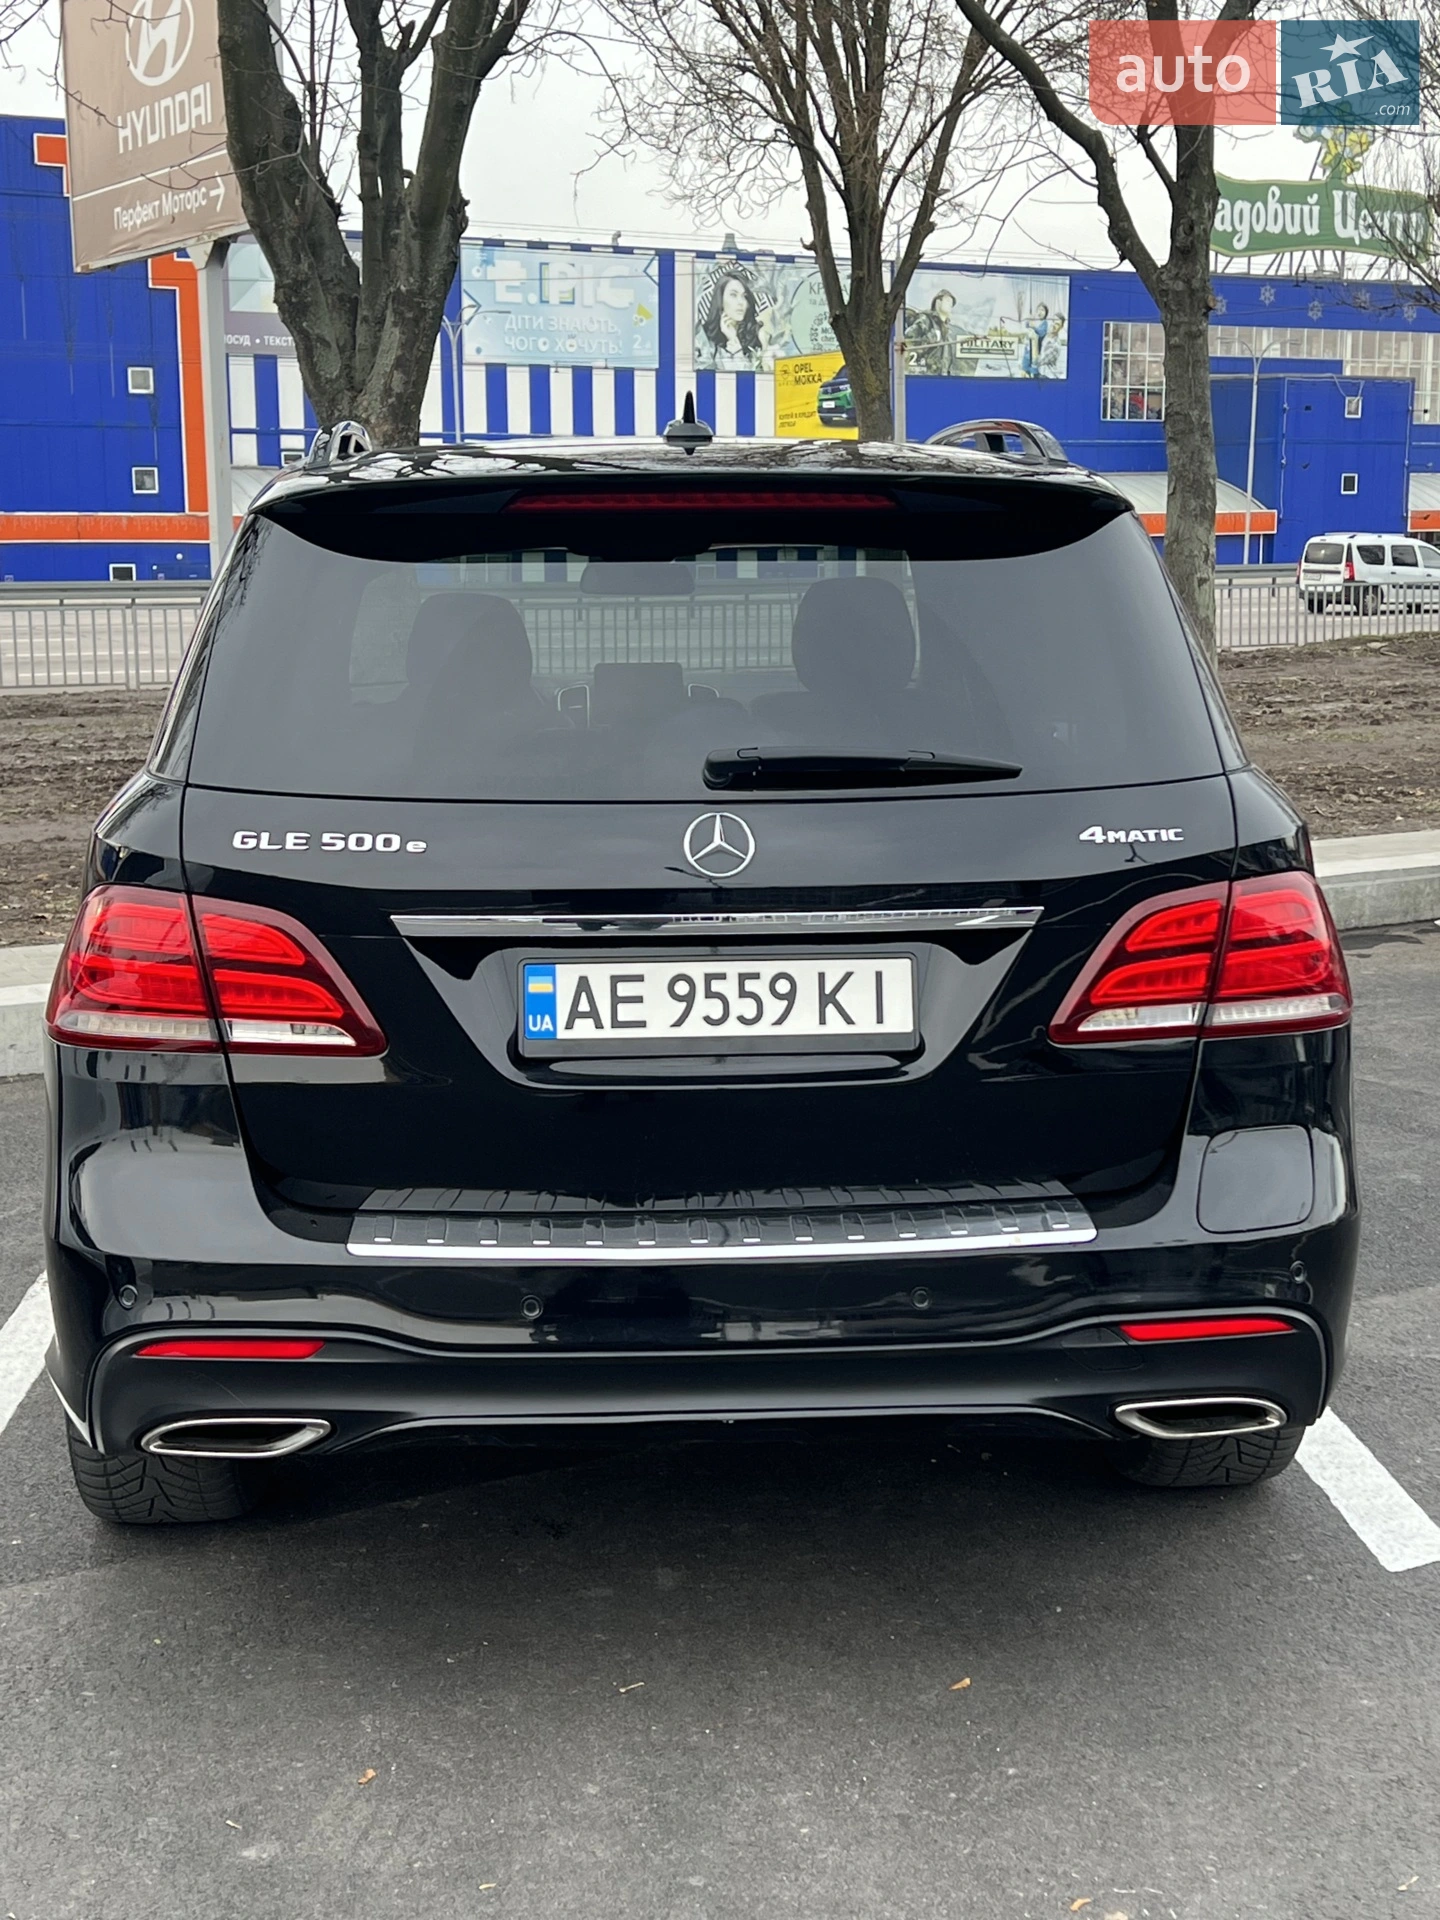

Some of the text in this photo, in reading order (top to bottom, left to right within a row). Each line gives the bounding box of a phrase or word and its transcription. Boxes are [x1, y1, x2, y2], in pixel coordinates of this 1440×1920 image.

[117, 82, 212, 154] HYUNDAI
[114, 186, 208, 232] Перфект Моторс
[1214, 185, 1321, 250] адовий
[504, 314, 622, 336] ДІТИ ЗНАЮТЬ,
[224, 334, 296, 347] ОСУД ТЕКСТ
[504, 336, 623, 355] ЧОГО ХОЧУТЬ!
[961, 340, 1014, 350] MILITARY
[794, 362, 813, 374] OPEL
[794, 373, 822, 386] MOKKA
[232, 830, 311, 850] GLE
[1079, 825, 1184, 844] 4MATIC
[564, 970, 885, 1030] AE 9559 KI
[528, 1014, 554, 1032] UA
